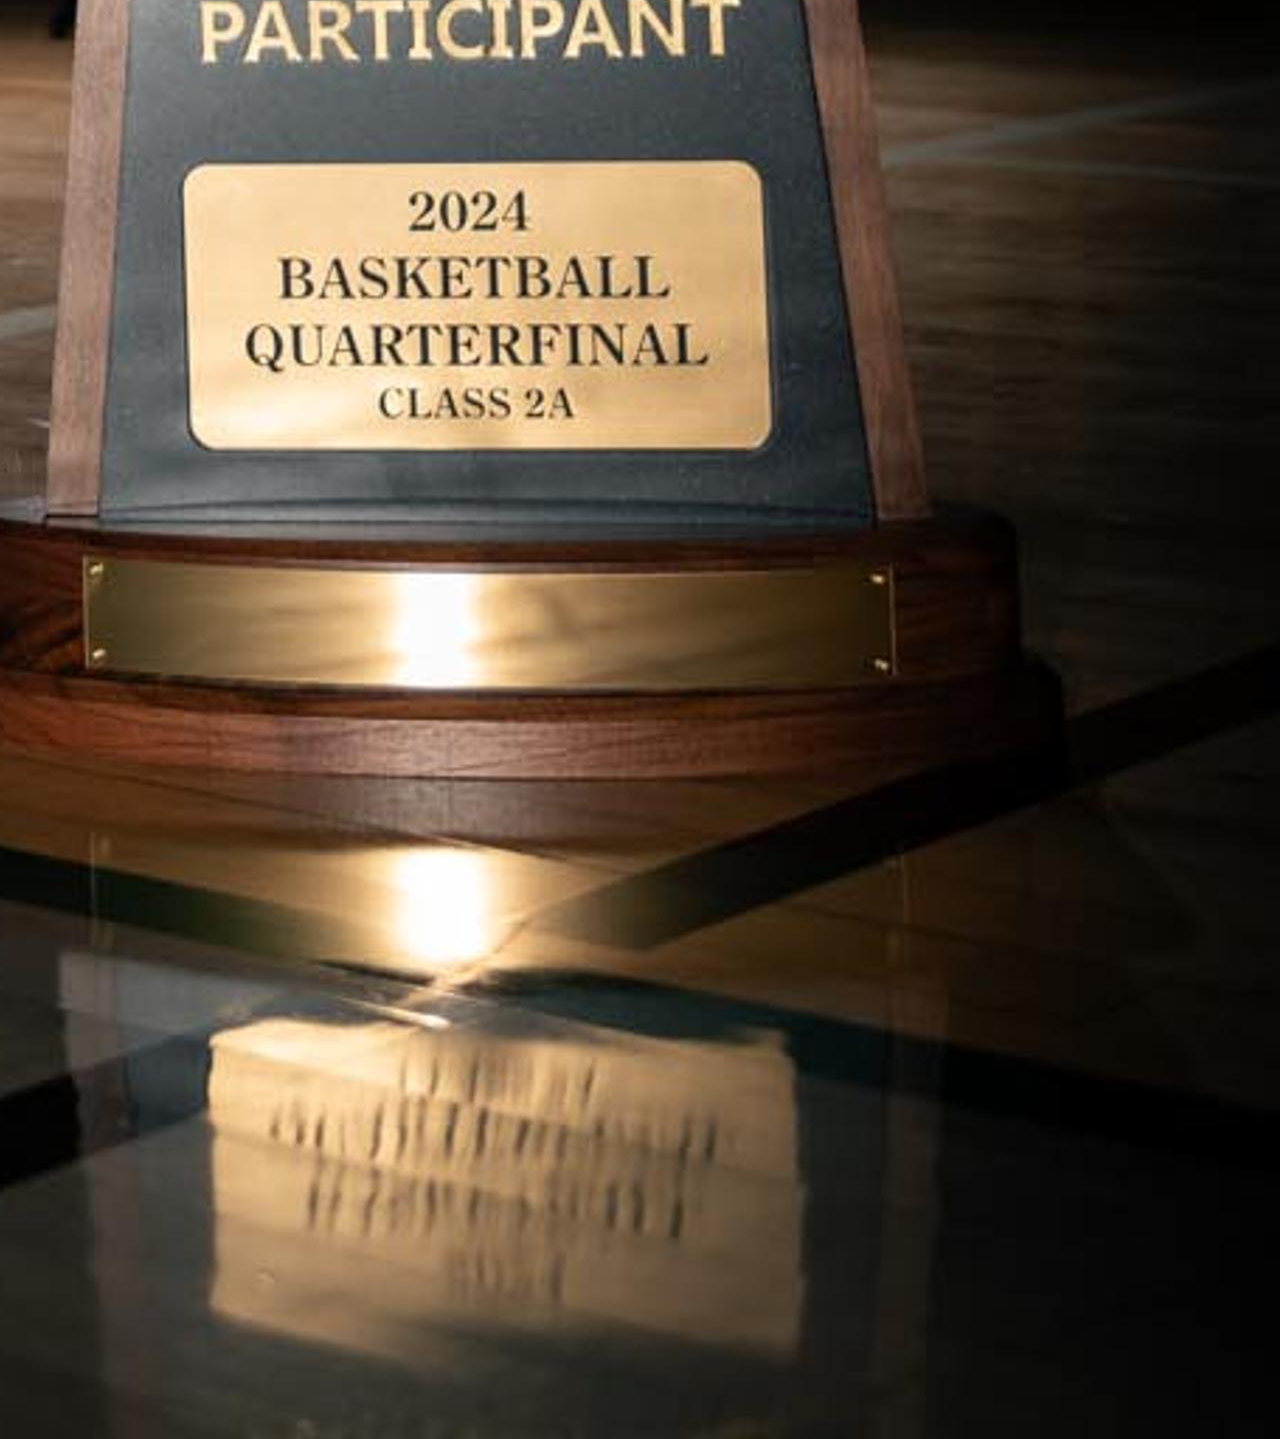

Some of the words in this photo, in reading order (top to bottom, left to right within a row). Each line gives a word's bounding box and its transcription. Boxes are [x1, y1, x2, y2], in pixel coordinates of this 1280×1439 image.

[407, 189, 530, 232] 2024
[278, 254, 671, 300] BASKETBALL
[244, 322, 710, 373] QUARTERFINAL
[378, 387, 512, 421] CLASS
[524, 386, 575, 420] 2A
